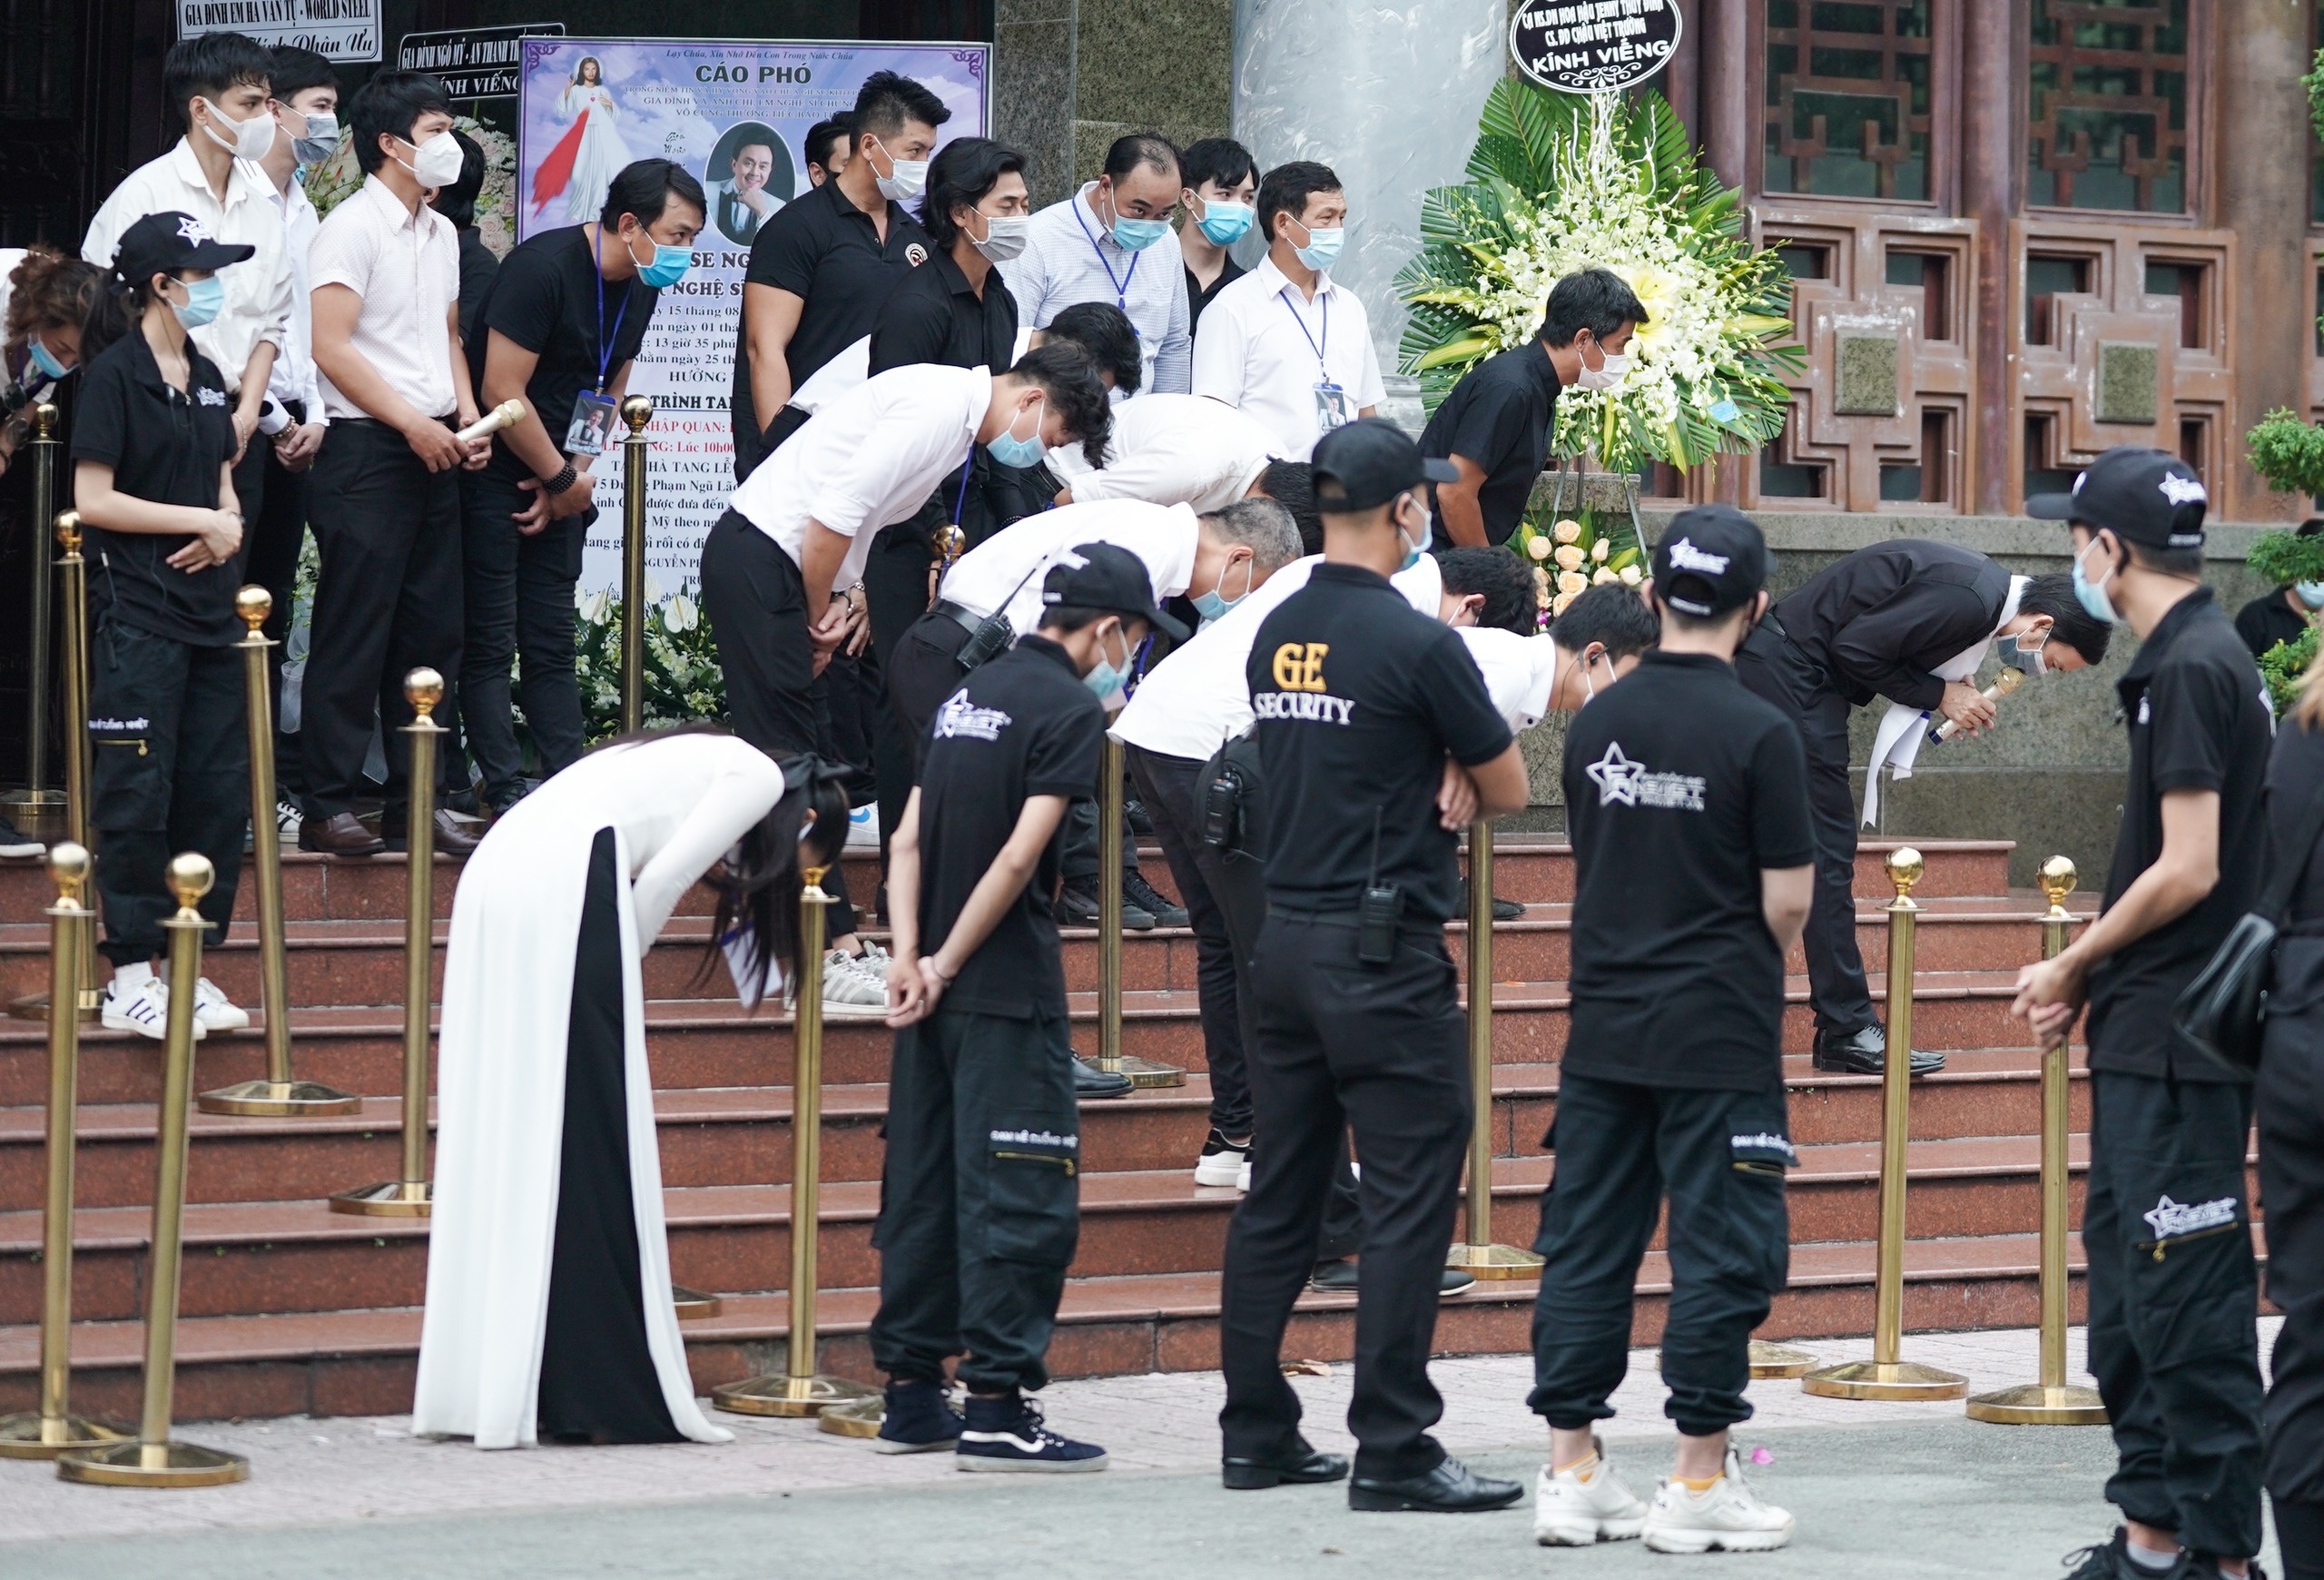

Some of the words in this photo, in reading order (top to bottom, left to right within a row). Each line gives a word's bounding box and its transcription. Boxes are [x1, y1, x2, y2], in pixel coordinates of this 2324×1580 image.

[185, 4, 202, 25] GIA
[305, 0, 339, 20] WORLD
[341, 0, 371, 19] STEEL
[1593, 19, 1612, 43] VIỆT
[402, 47, 415, 69] GIA
[666, 49, 681, 59] Lạy
[709, 50, 724, 58] Xin
[764, 51, 780, 59] Con
[783, 52, 806, 60] Trong
[809, 52, 829, 60] Nước
[832, 52, 853, 60] Chúa
[1532, 52, 1589, 74] KÍNH
[1597, 38, 1670, 64] VIẾNG
[696, 61, 749, 83] CÁO
[759, 63, 812, 84] PHÓ
[440, 72, 468, 94] ÍNH
[665, 95, 690, 104] ĐÌNH
[712, 97, 733, 105] ANH
[676, 107, 690, 116] VÔ
[673, 279, 724, 299] NGHỆ
[669, 306, 681, 315] 15
[685, 305, 721, 317] tháng
[725, 307, 740, 316] 08
[667, 321, 697, 333] ngày
[701, 322, 714, 332] 01
[655, 338, 668, 347] 13
[672, 338, 691, 350] giờ
[694, 339, 709, 348] 35
[672, 354, 701, 366] ngày
[705, 354, 719, 364] 25
[669, 368, 726, 382] HƯỞNG
[650, 392, 701, 409] TRÌNH
[683, 421, 725, 434] QUAN:
[677, 440, 699, 453] Lúc
[673, 461, 710, 473] TANG
[714, 457, 732, 473] LỄ
[653, 479, 686, 493] Phạm
[690, 479, 713, 493] Ngũ
[646, 498, 675, 510] được
[677, 499, 699, 509] đưa
[702, 498, 724, 509] đến
[652, 516, 670, 528] Mỹ
[675, 516, 700, 528] theo
[656, 535, 673, 548] rối
[676, 537, 690, 548] có
[1273, 642, 1329, 693] GE
[1255, 692, 1355, 726] SECURITY
